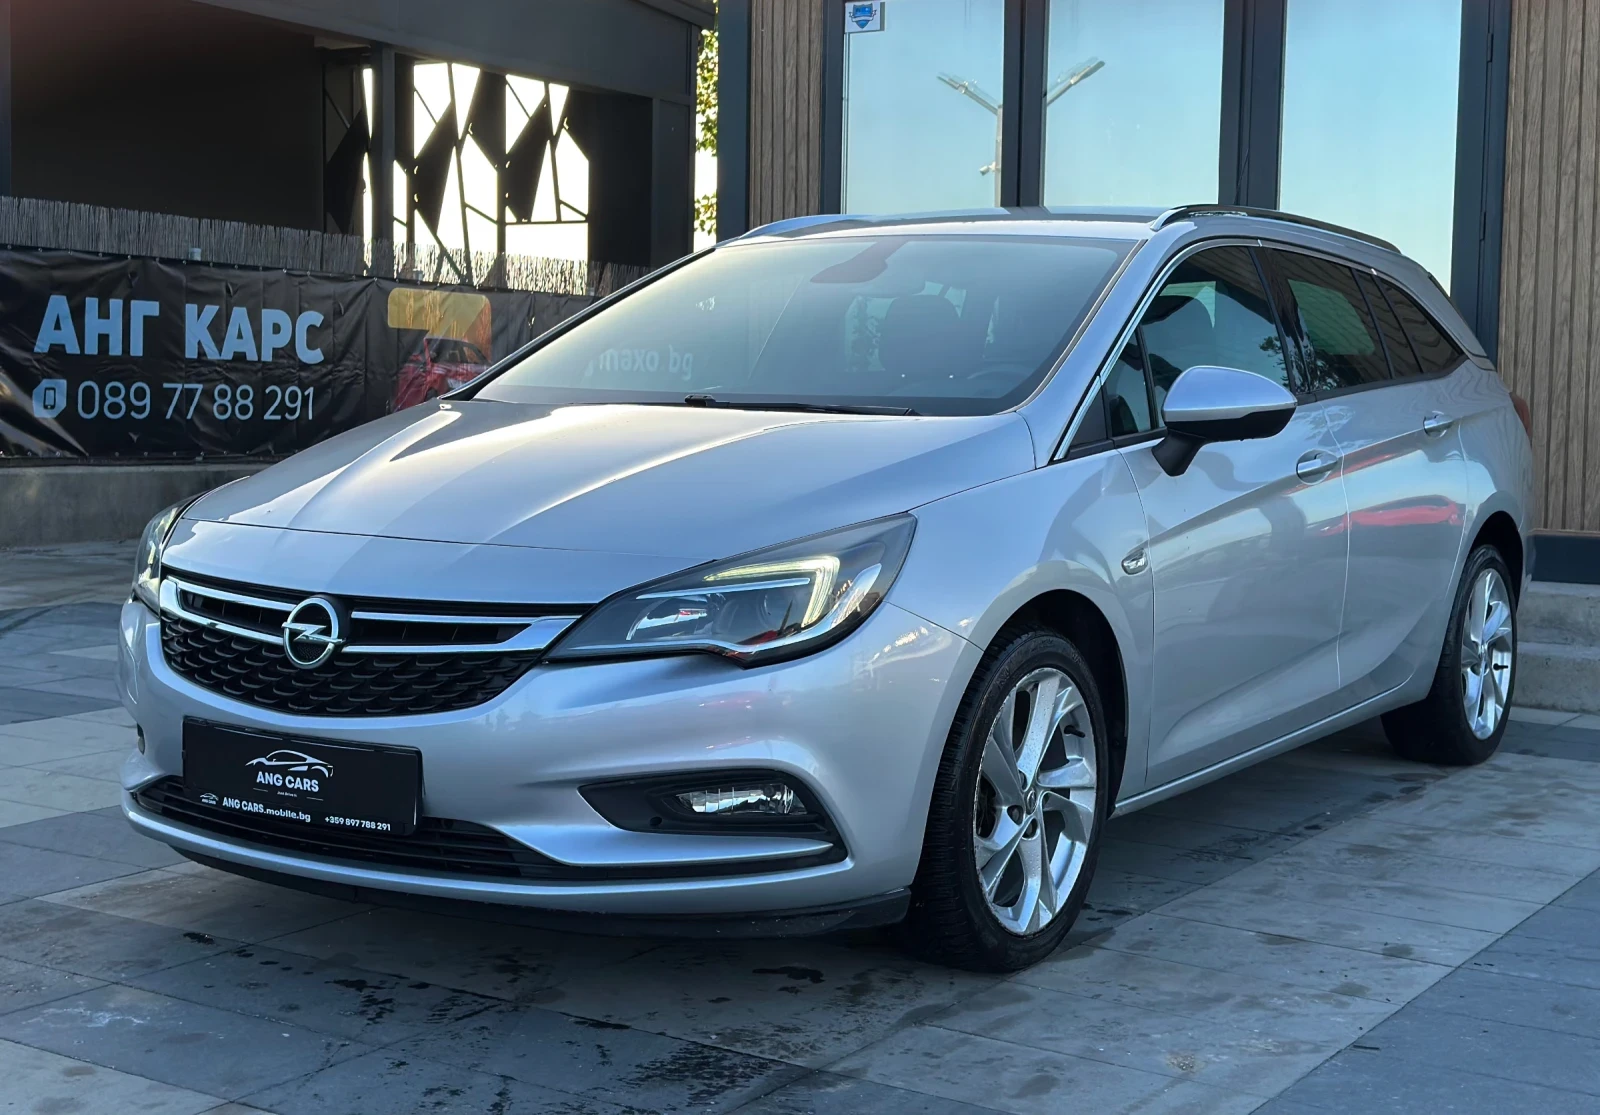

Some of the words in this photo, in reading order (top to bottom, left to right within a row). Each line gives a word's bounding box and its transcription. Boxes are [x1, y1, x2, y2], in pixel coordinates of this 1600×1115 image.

[33, 294, 160, 357] АНГ
[185, 303, 325, 365] КАРС
[77, 380, 151, 420] 089
[162, 383, 204, 419] 77
[213, 384, 254, 420] 88
[263, 386, 314, 420] 291
[256, 771, 283, 787] ANG
[285, 775, 319, 793] CARS
[222, 796, 240, 811] ANG
[241, 800, 311, 823] CARS.mobile.bg
[324, 816, 345, 826] +359
[345, 817, 360, 828] 897
[360, 819, 377, 829] 788
[377, 822, 391, 832] 291
